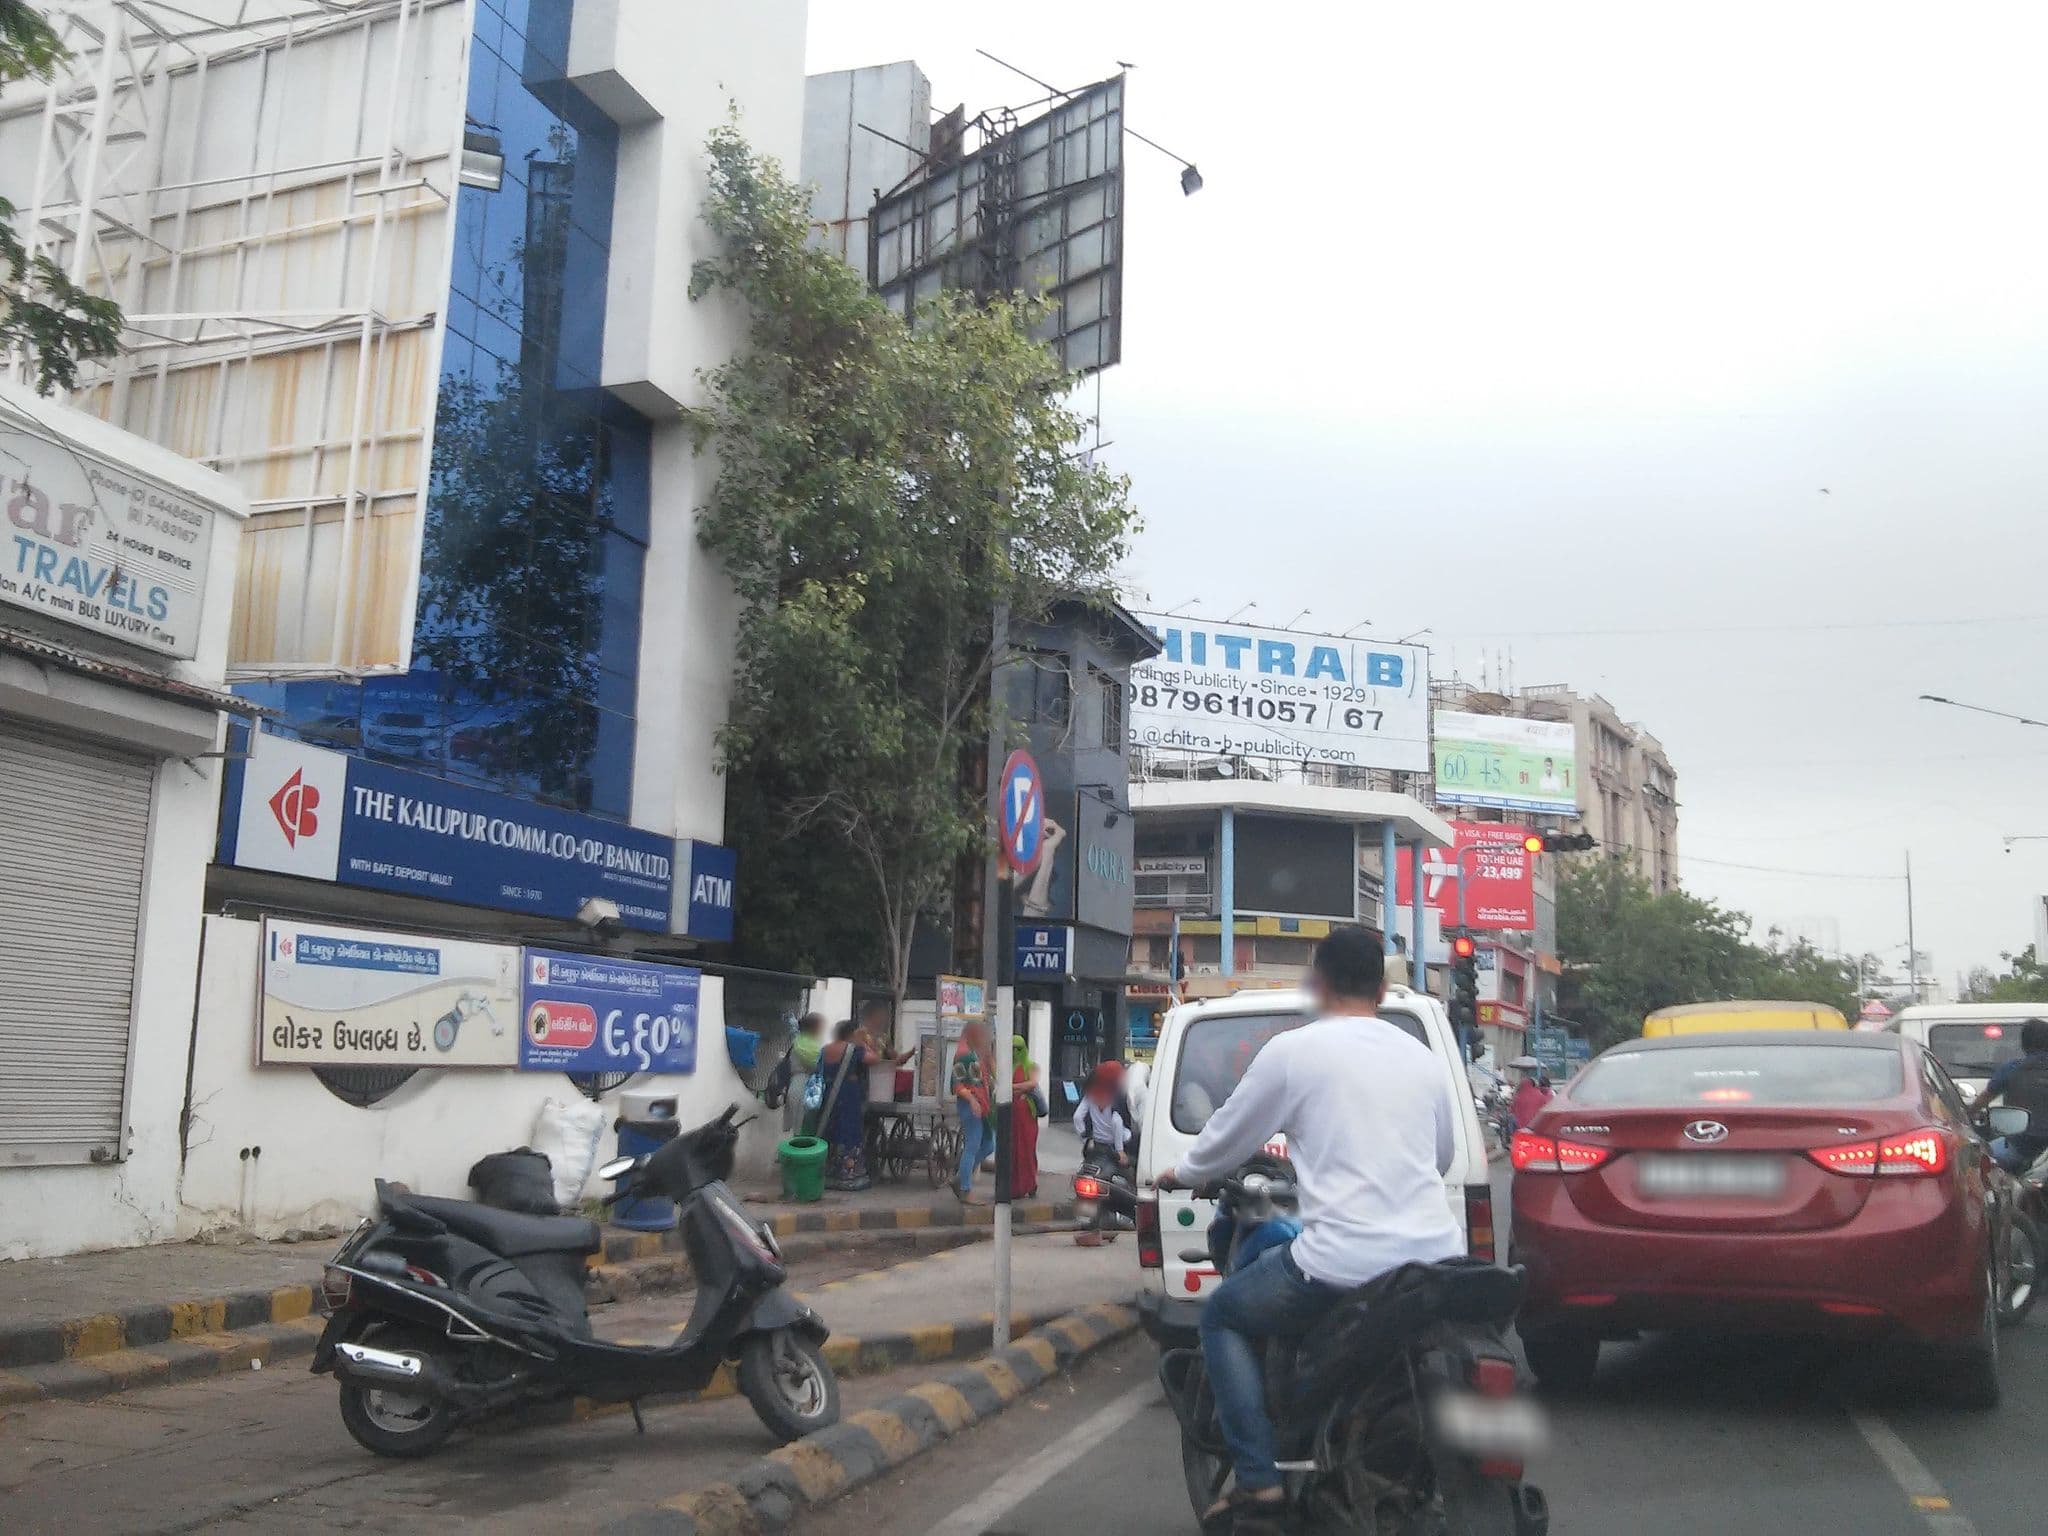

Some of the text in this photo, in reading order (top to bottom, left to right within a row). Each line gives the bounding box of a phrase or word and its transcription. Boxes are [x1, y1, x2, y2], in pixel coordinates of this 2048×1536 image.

[14, 535, 169, 622] TRAVELS
[22, 582, 46, 603] A/C
[50, 594, 74, 612] mini
[78, 600, 100, 621] BUS
[105, 609, 150, 634] LUXURY
[1184, 671, 1248, 695] Publicity
[1344, 708, 1384, 731] 67
[353, 786, 395, 822] THE
[397, 796, 487, 842] KALUPUR
[606, 844, 645, 874] BANK
[645, 853, 671, 881] LTD.
[1487, 831, 1504, 840] FREE
[350, 858, 372, 872] WITH
[372, 861, 395, 876] SAFE
[395, 865, 430, 882] DEPOSIT
[1087, 841, 1126, 885] ORRA
[1508, 857, 1524, 867] UAE
[502, 884, 522, 896] SINCE
[693, 873, 732, 908] ATM
[1023, 952, 1059, 968] ATM
[272, 1015, 323, 1050] લોકર
[334, 1020, 398, 1051] ઉપલબ્ધ
